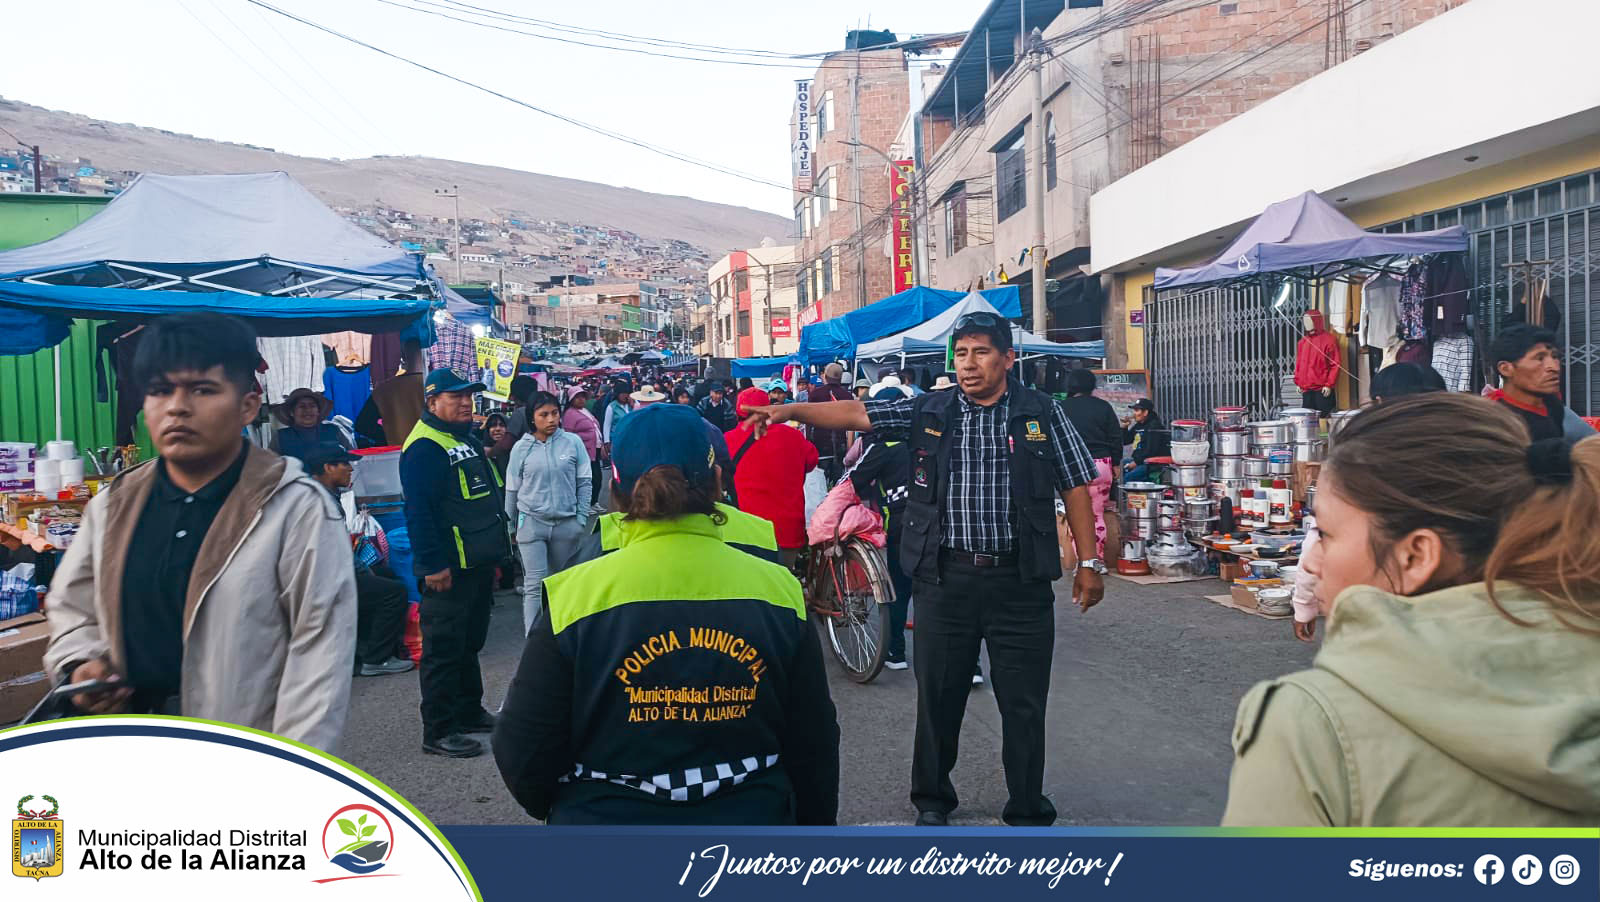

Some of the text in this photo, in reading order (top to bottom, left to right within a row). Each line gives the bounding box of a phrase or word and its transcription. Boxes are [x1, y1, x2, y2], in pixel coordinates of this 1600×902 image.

[798, 83, 809, 170] HOSPEDAJE
[478, 347, 487, 355] EN
[615, 627, 768, 684] POLICIA MUNICIPAL
[713, 685, 757, 703] Distrital
[628, 707, 660, 722] ALTO
[664, 706, 678, 721] DE
[683, 707, 698, 721] LA
